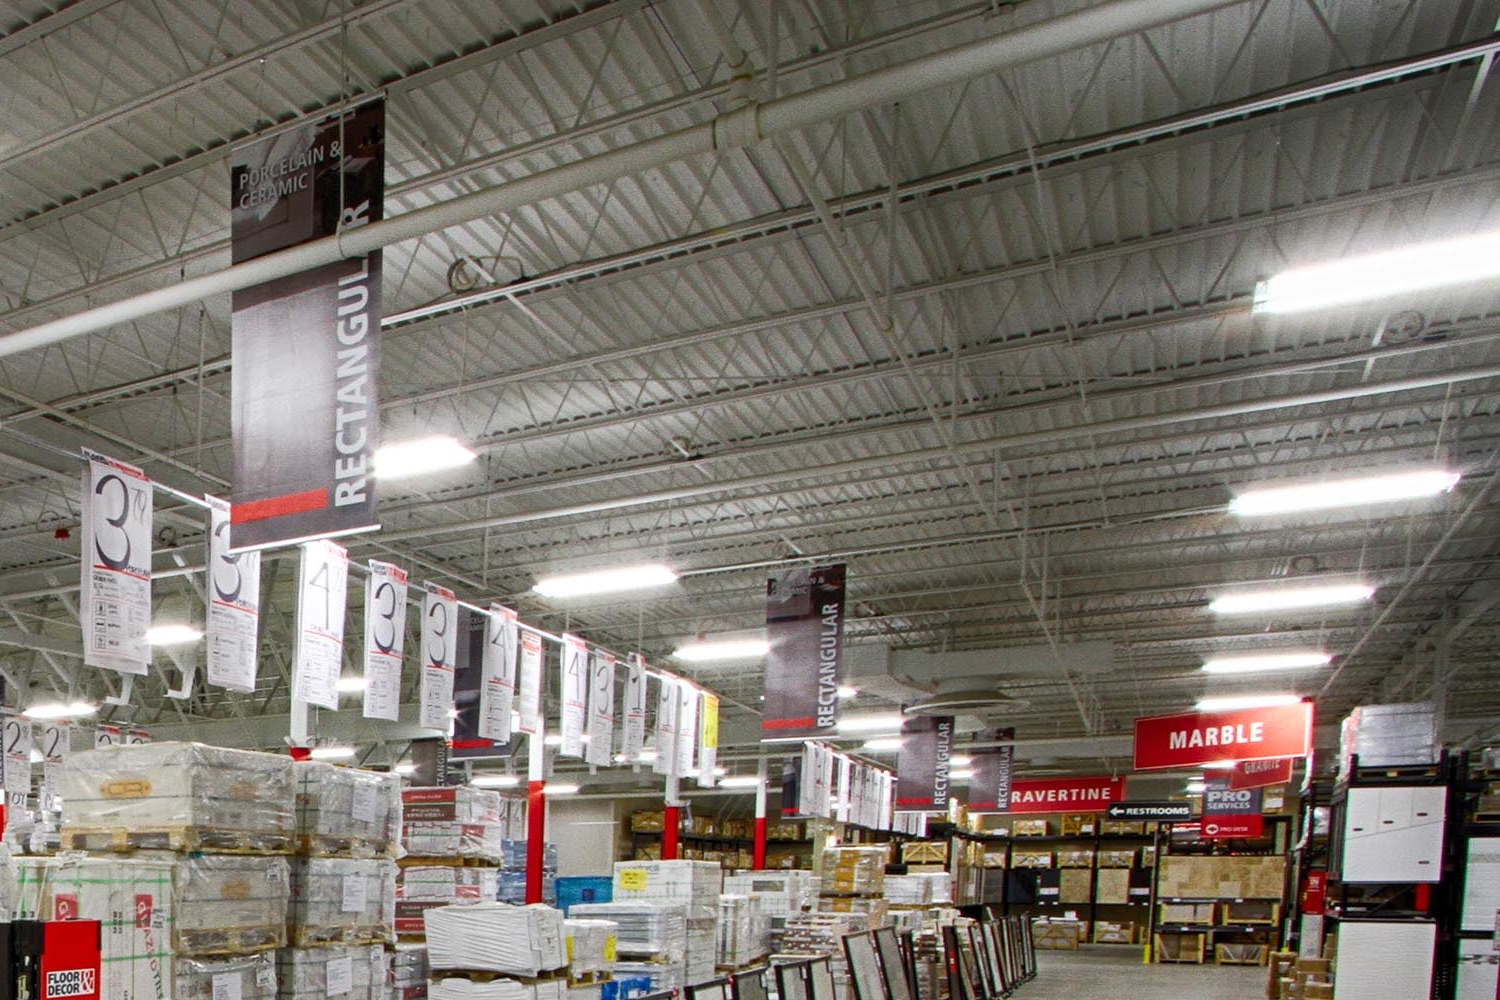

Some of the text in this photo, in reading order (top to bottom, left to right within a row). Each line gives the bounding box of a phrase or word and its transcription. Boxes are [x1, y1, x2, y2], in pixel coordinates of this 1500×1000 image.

[239, 146, 324, 190] PORCELAIN
[239, 172, 309, 210] CERAMIC
[335, 199, 370, 507] RECTANGULR
[95, 474, 131, 569] 3
[373, 582, 396, 654] 3
[816, 602, 839, 728] RECTANGULAR
[1169, 722, 1264, 750] MARBLE
[934, 722, 950, 805] RECTANGULAR
[1011, 786, 1112, 804] RAVERTINE
[1125, 806, 1190, 816] RESTROOMS
[1207, 790, 1252, 802] PRO
[1207, 802, 1251, 811] SERVICES
[48, 971, 80, 985] FLOOR
[48, 968, 94, 996] DECOR &
